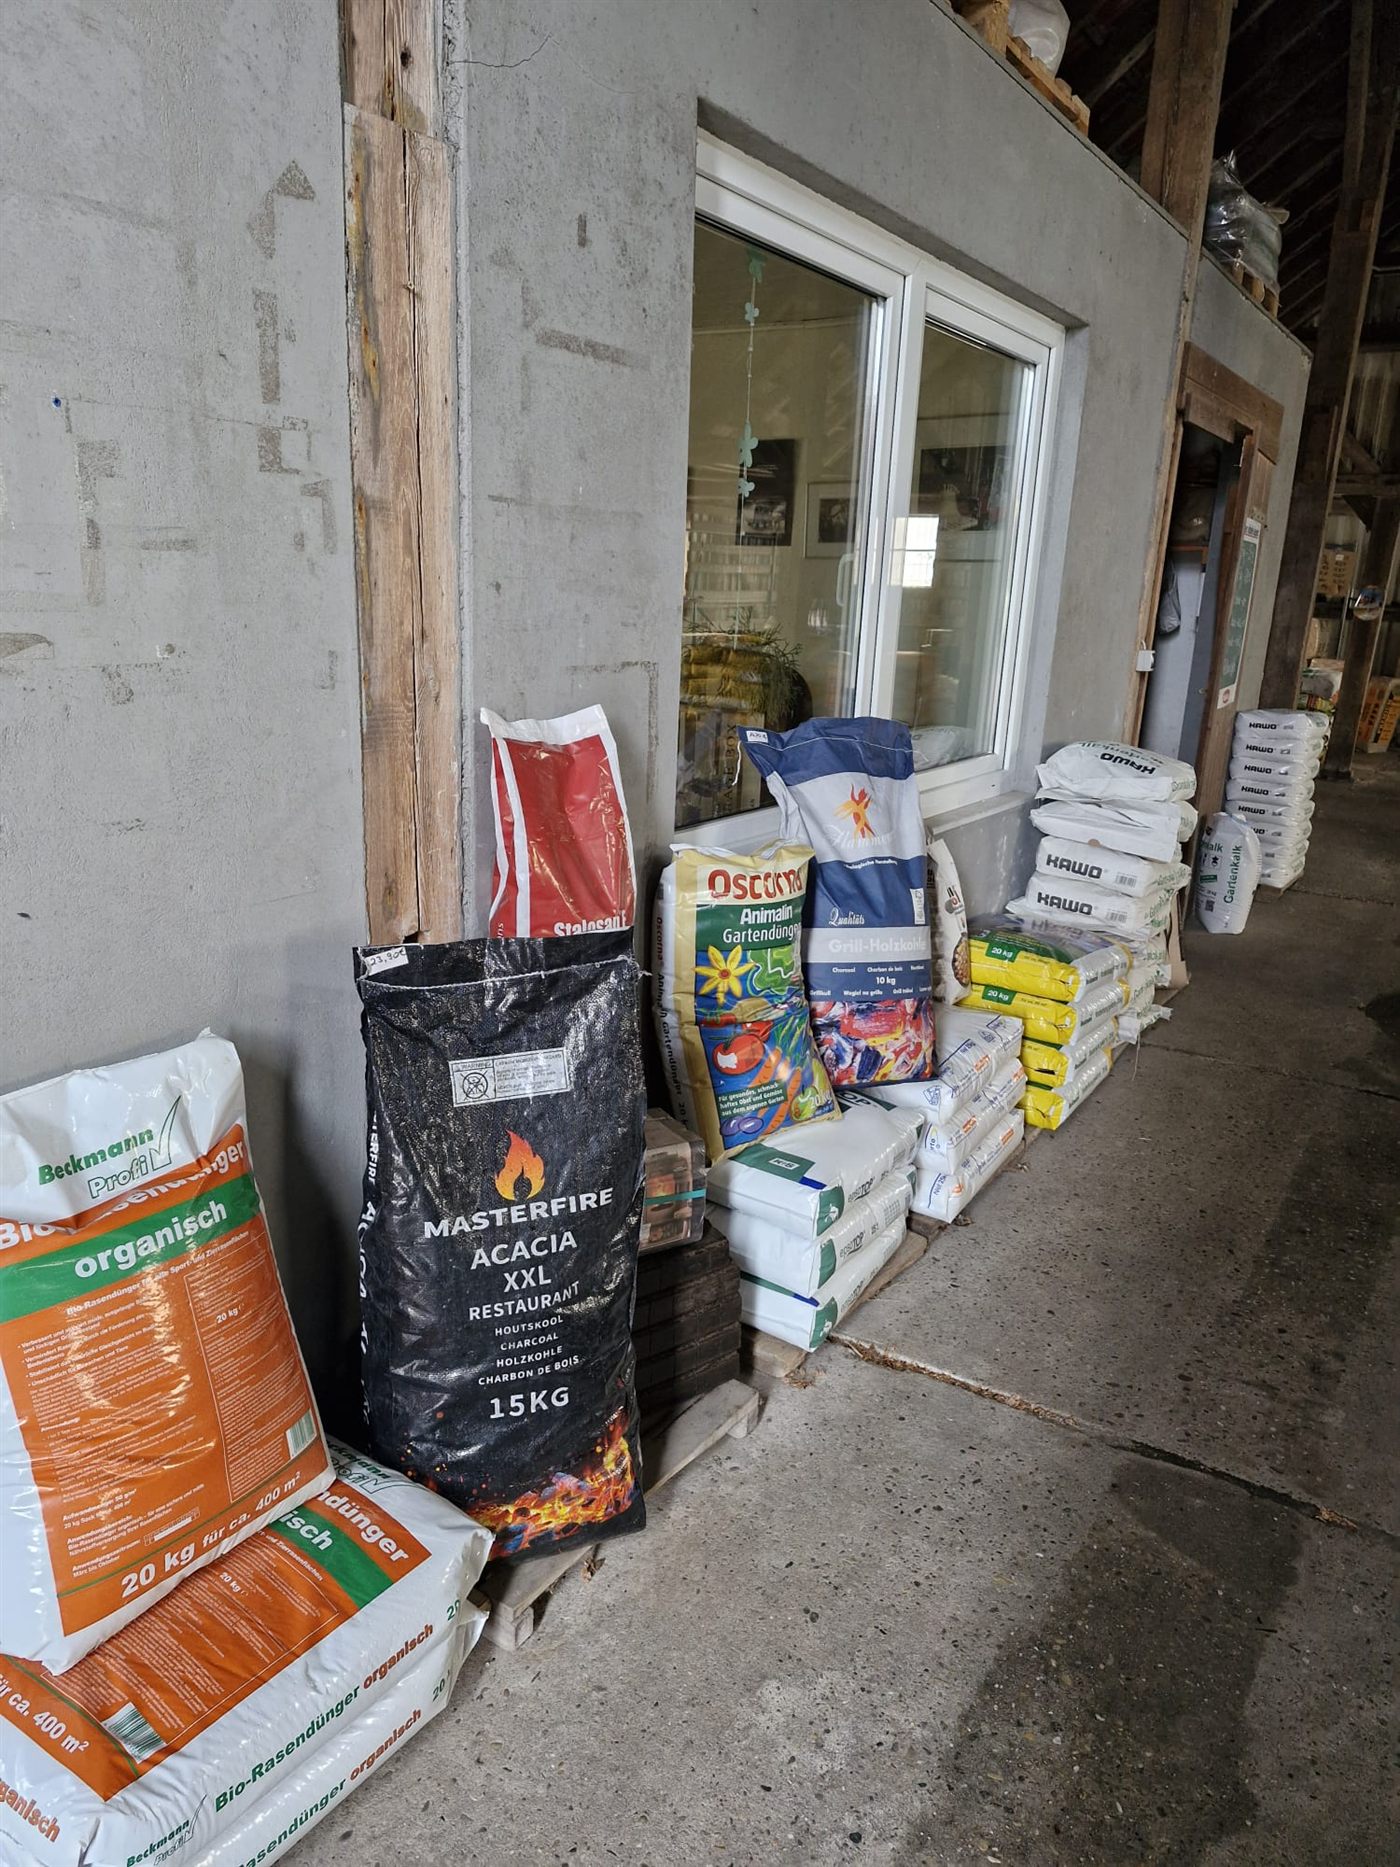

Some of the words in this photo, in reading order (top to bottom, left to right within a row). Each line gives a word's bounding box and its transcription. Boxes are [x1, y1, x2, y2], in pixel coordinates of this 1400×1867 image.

[1223, 844, 1243, 904] Gartenkalk
[553, 914, 621, 938] Stalosan
[739, 903, 794, 926] Animalin
[656, 915, 664, 961] Oscorna
[828, 936, 927, 954] Grill-Holzkohle
[991, 947, 1002, 955] 20
[1002, 949, 1014, 959] kg
[876, 976, 885, 985] 10
[885, 975, 897, 986] kg
[987, 989, 999, 997] 20
[999, 993, 1010, 1002] kg
[720, 1100, 738, 1110] haftes
[739, 1097, 752, 1106] Obst
[752, 1094, 763, 1102] und
[763, 1089, 783, 1099] Gemüse
[721, 1109, 732, 1117] aus
[732, 1106, 745, 1114] dem
[746, 1101, 768, 1112] eigenen
[768, 1095, 785, 1105] Garten
[37, 1127, 155, 1186] Beckmann
[87, 1156, 149, 1200] Profi
[423, 1187, 615, 1239] MASTERFIRE
[74, 1199, 228, 1279] organisch
[469, 1230, 578, 1271] ACACIA
[65, 1280, 142, 1317] Bio-Rasendünger
[170, 1259, 193, 1274] Sport-
[502, 1265, 553, 1293] XXL
[216, 1313, 228, 1324] 20
[228, 1307, 239, 1318] kg
[468, 1280, 581, 1322] RESTAURANT
[494, 1314, 565, 1338] HOUTSKOOL
[499, 1331, 560, 1352] CHARCOAL
[477, 1368, 535, 1387] CHARBON
[536, 1365, 552, 1377] DE
[553, 1354, 581, 1372] BOIS
[495, 1345, 564, 1369] HOLZKOHLE
[489, 1386, 571, 1420] 15KG
[121, 1562, 157, 1599] 20
[164, 1542, 196, 1573] kg
[202, 1525, 226, 1548] für
[229, 1513, 251, 1532] ca.
[255, 1485, 282, 1513] 400
[283, 1471, 302, 1493] m²
[275, 1539, 324, 1582] Zierrasenflächen
[219, 1571, 232, 1584] 20
[229, 1579, 242, 1594] kg
[8, 1692, 31, 1717] ca.
[32, 1710, 68, 1741] 400
[60, 1733, 91, 1754] m²
[214, 1684, 361, 1815] Bio-Rasendünger
[363, 1622, 435, 1691] organisch
[240, 1777, 347, 1867] asendünger
[349, 1707, 423, 1783] organisch
[431, 1677, 446, 1702] 20
[126, 1818, 191, 1867] Beckmann
